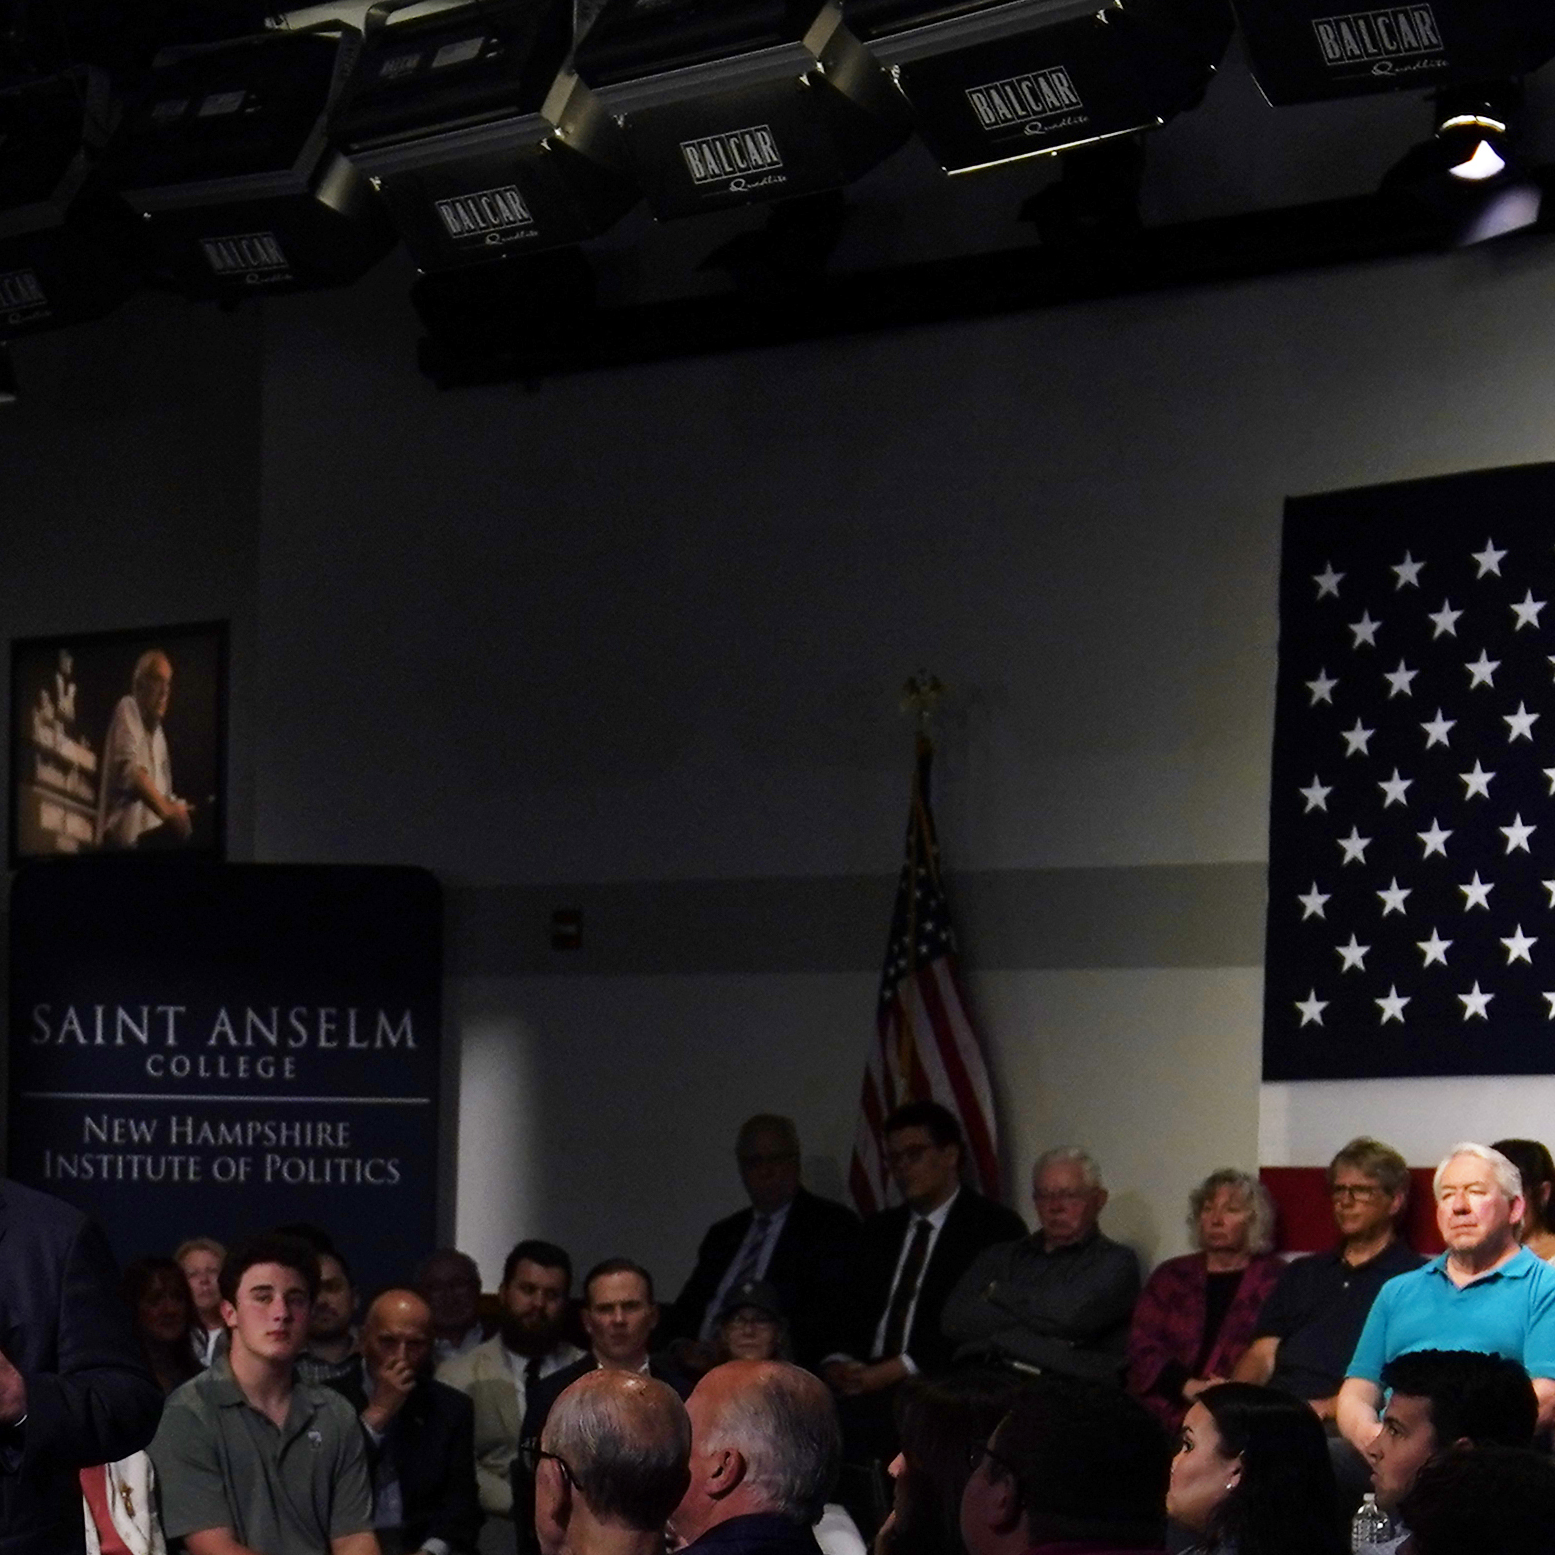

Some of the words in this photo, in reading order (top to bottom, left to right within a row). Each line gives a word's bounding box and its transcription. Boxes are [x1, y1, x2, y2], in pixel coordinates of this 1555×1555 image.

[1318, 10, 1439, 59] BALCAR
[971, 72, 1078, 124] BALCAR
[685, 130, 779, 179] BALCAR
[440, 190, 529, 233] BALCAR
[31, 1003, 187, 1048] SAINT
[207, 1005, 418, 1050] ANSELM
[146, 1054, 297, 1080] COLLEGE
[83, 1114, 157, 1145] NEW
[170, 1116, 350, 1149] HAMPSHIRE
[43, 1149, 202, 1181] INSTITUTE
[265, 1153, 401, 1184] POLITICS
